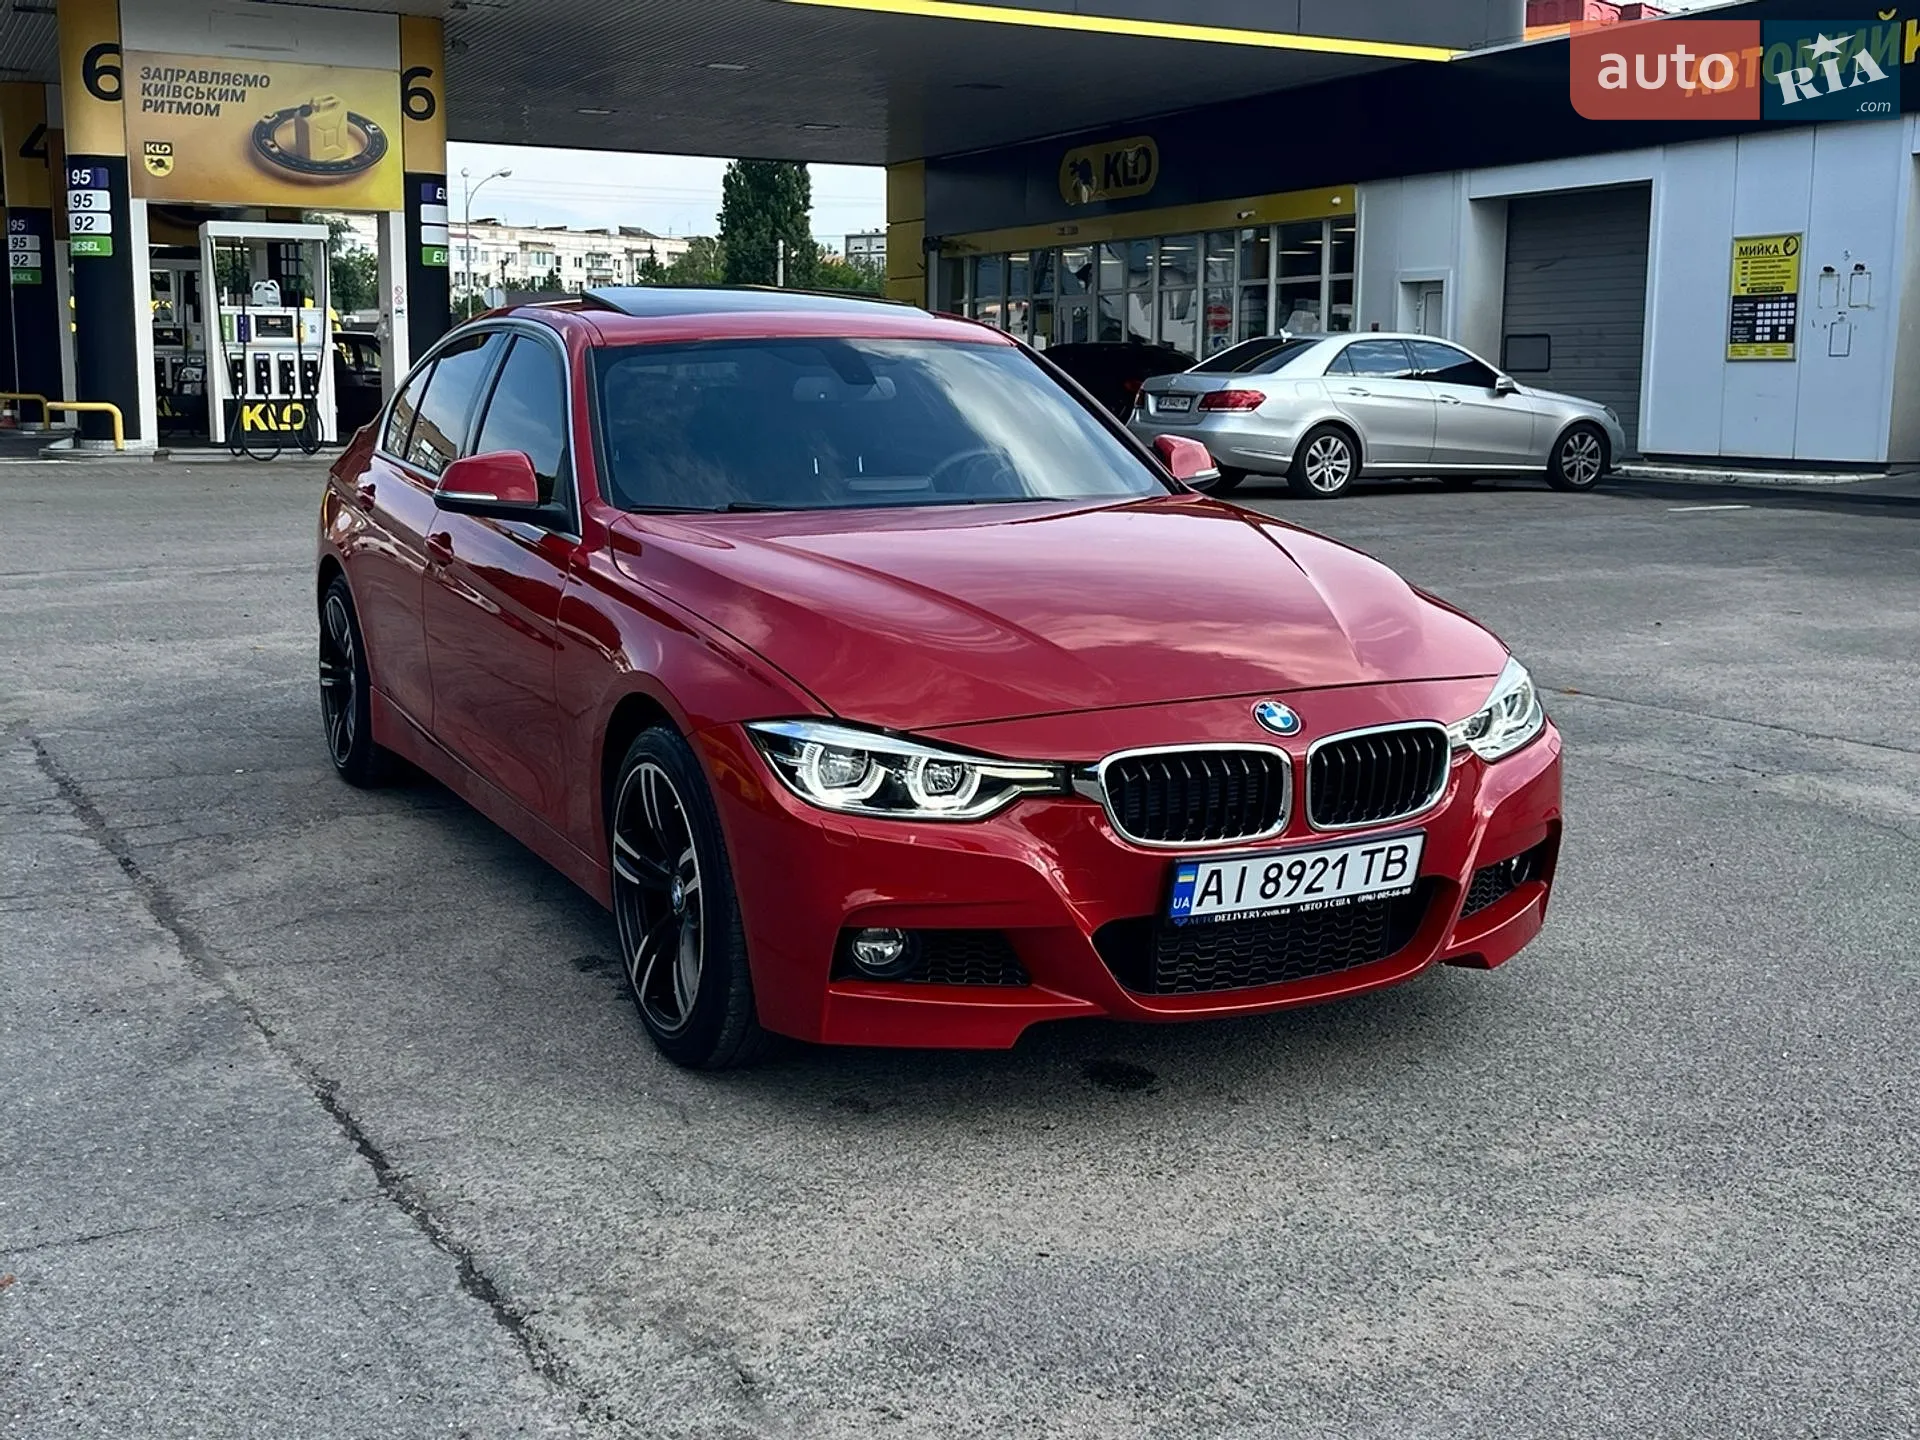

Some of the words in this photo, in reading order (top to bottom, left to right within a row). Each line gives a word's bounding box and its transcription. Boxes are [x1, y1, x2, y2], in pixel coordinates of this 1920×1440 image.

[82, 43, 122, 101] 6
[140, 66, 271, 88] ЗАПРАВЛЯЄМО
[141, 81, 247, 103] КИЇВСЬКИМ
[401, 66, 436, 121] 6
[142, 98, 221, 117] РИТМОМ
[145, 143, 171, 154] KLO
[71, 169, 91, 185] 95
[73, 193, 93, 209] 95
[10, 219, 26, 231] 95
[74, 216, 95, 231] 92
[12, 237, 27, 249] 95
[1739, 243, 1779, 256] МИЙКА
[13, 254, 28, 266] 92
[242, 402, 306, 431] KLO
[1196, 866, 1247, 907] AI
[1260, 853, 1349, 900] 8921
[1361, 844, 1409, 885] TB
[1173, 896, 1190, 909] UA
